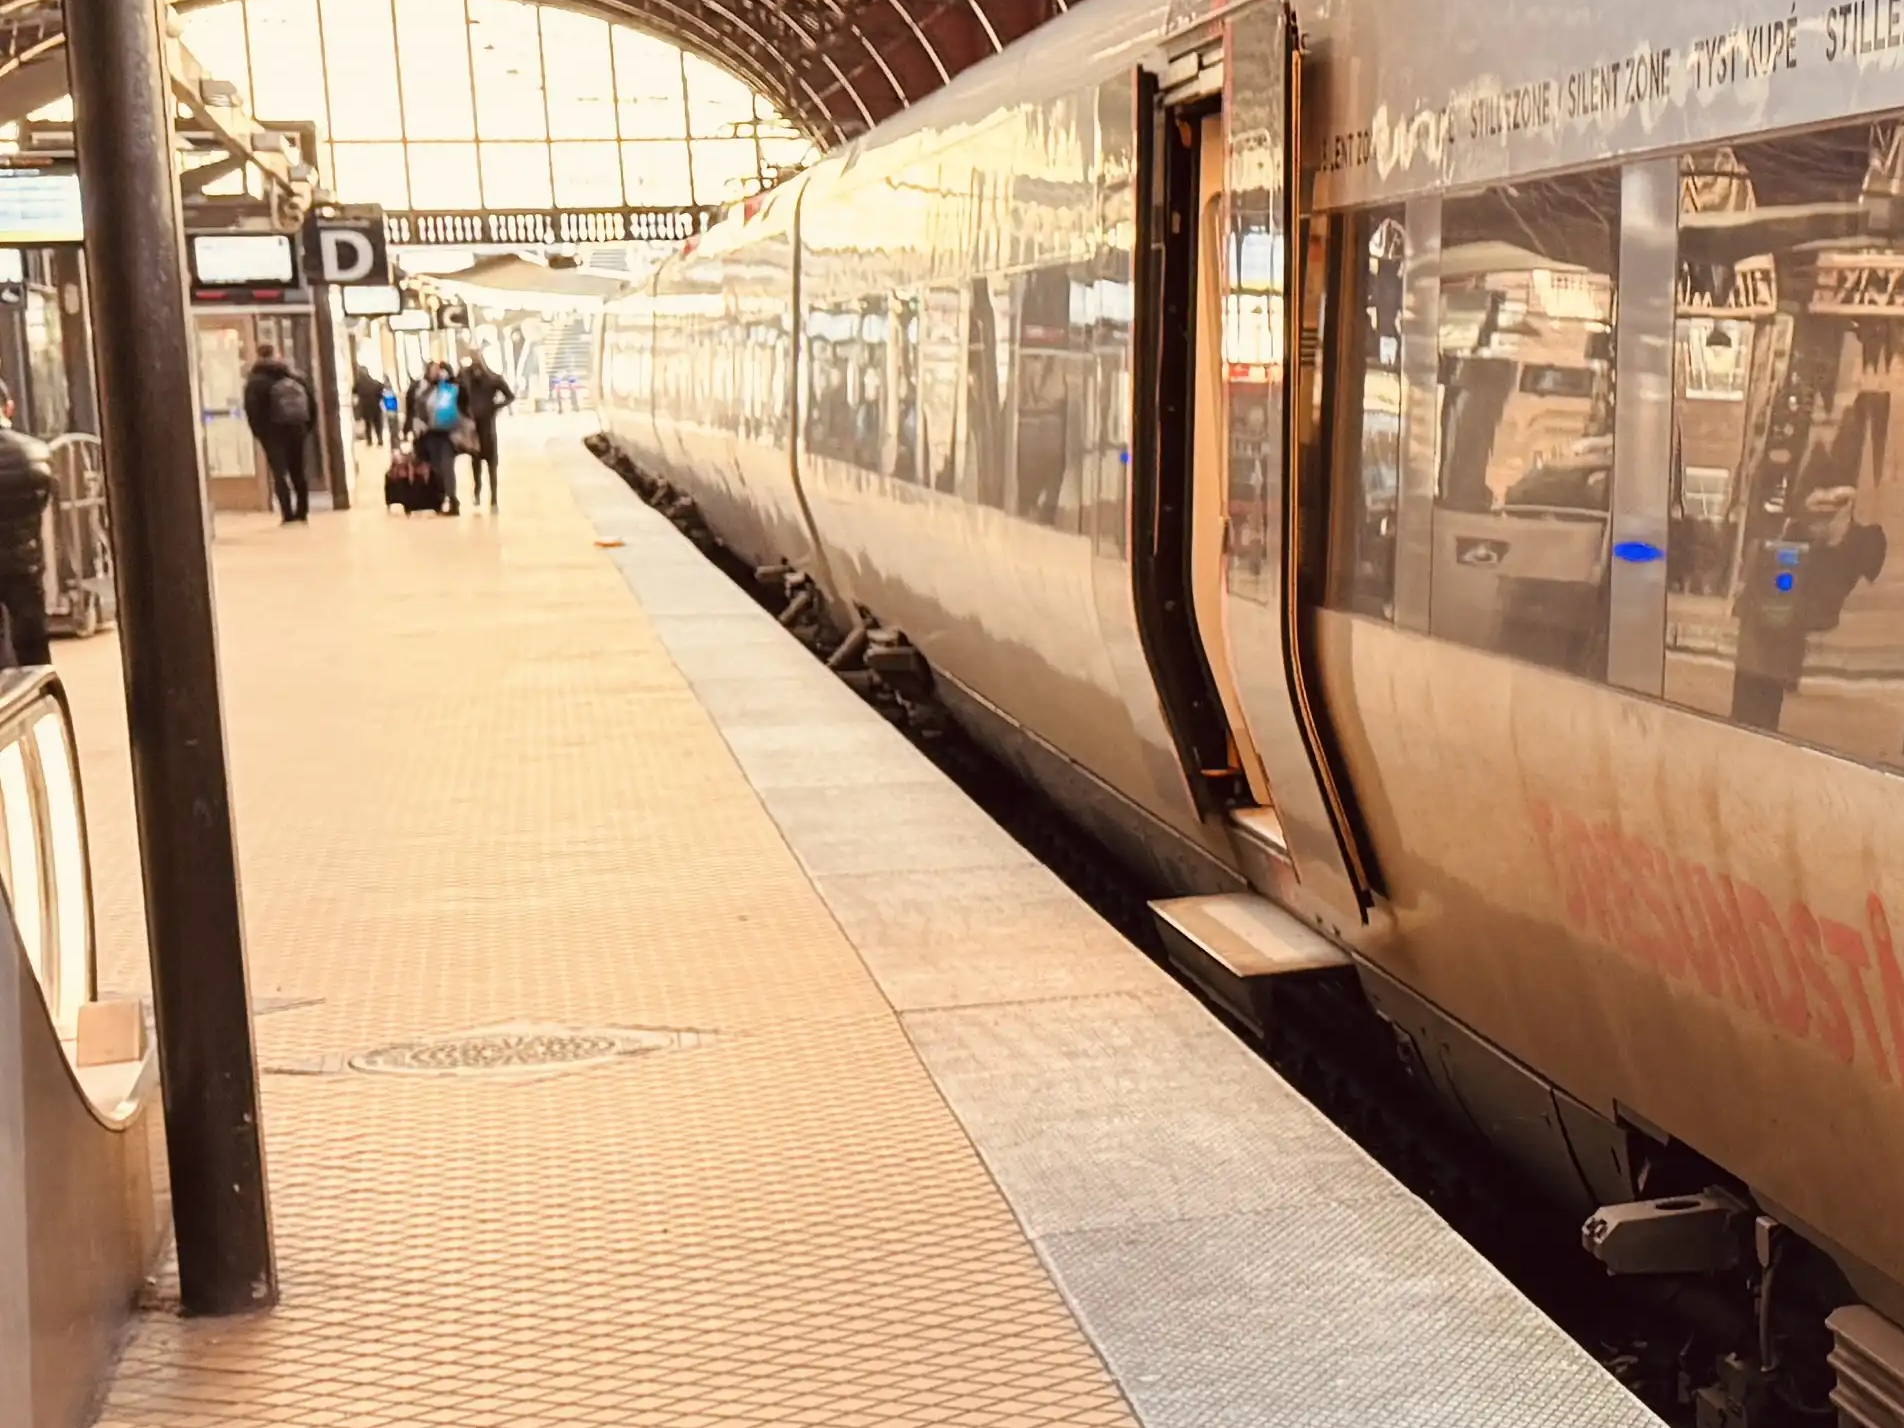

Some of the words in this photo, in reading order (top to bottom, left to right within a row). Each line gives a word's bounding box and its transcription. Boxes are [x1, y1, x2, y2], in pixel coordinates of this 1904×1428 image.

[1469, 80, 1551, 139] STILLEZONE
[1567, 61, 1621, 119] SILENT
[1624, 47, 1672, 105] ZONE
[1745, 1, 1798, 79] KUPÉ
[320, 229, 374, 282] D
